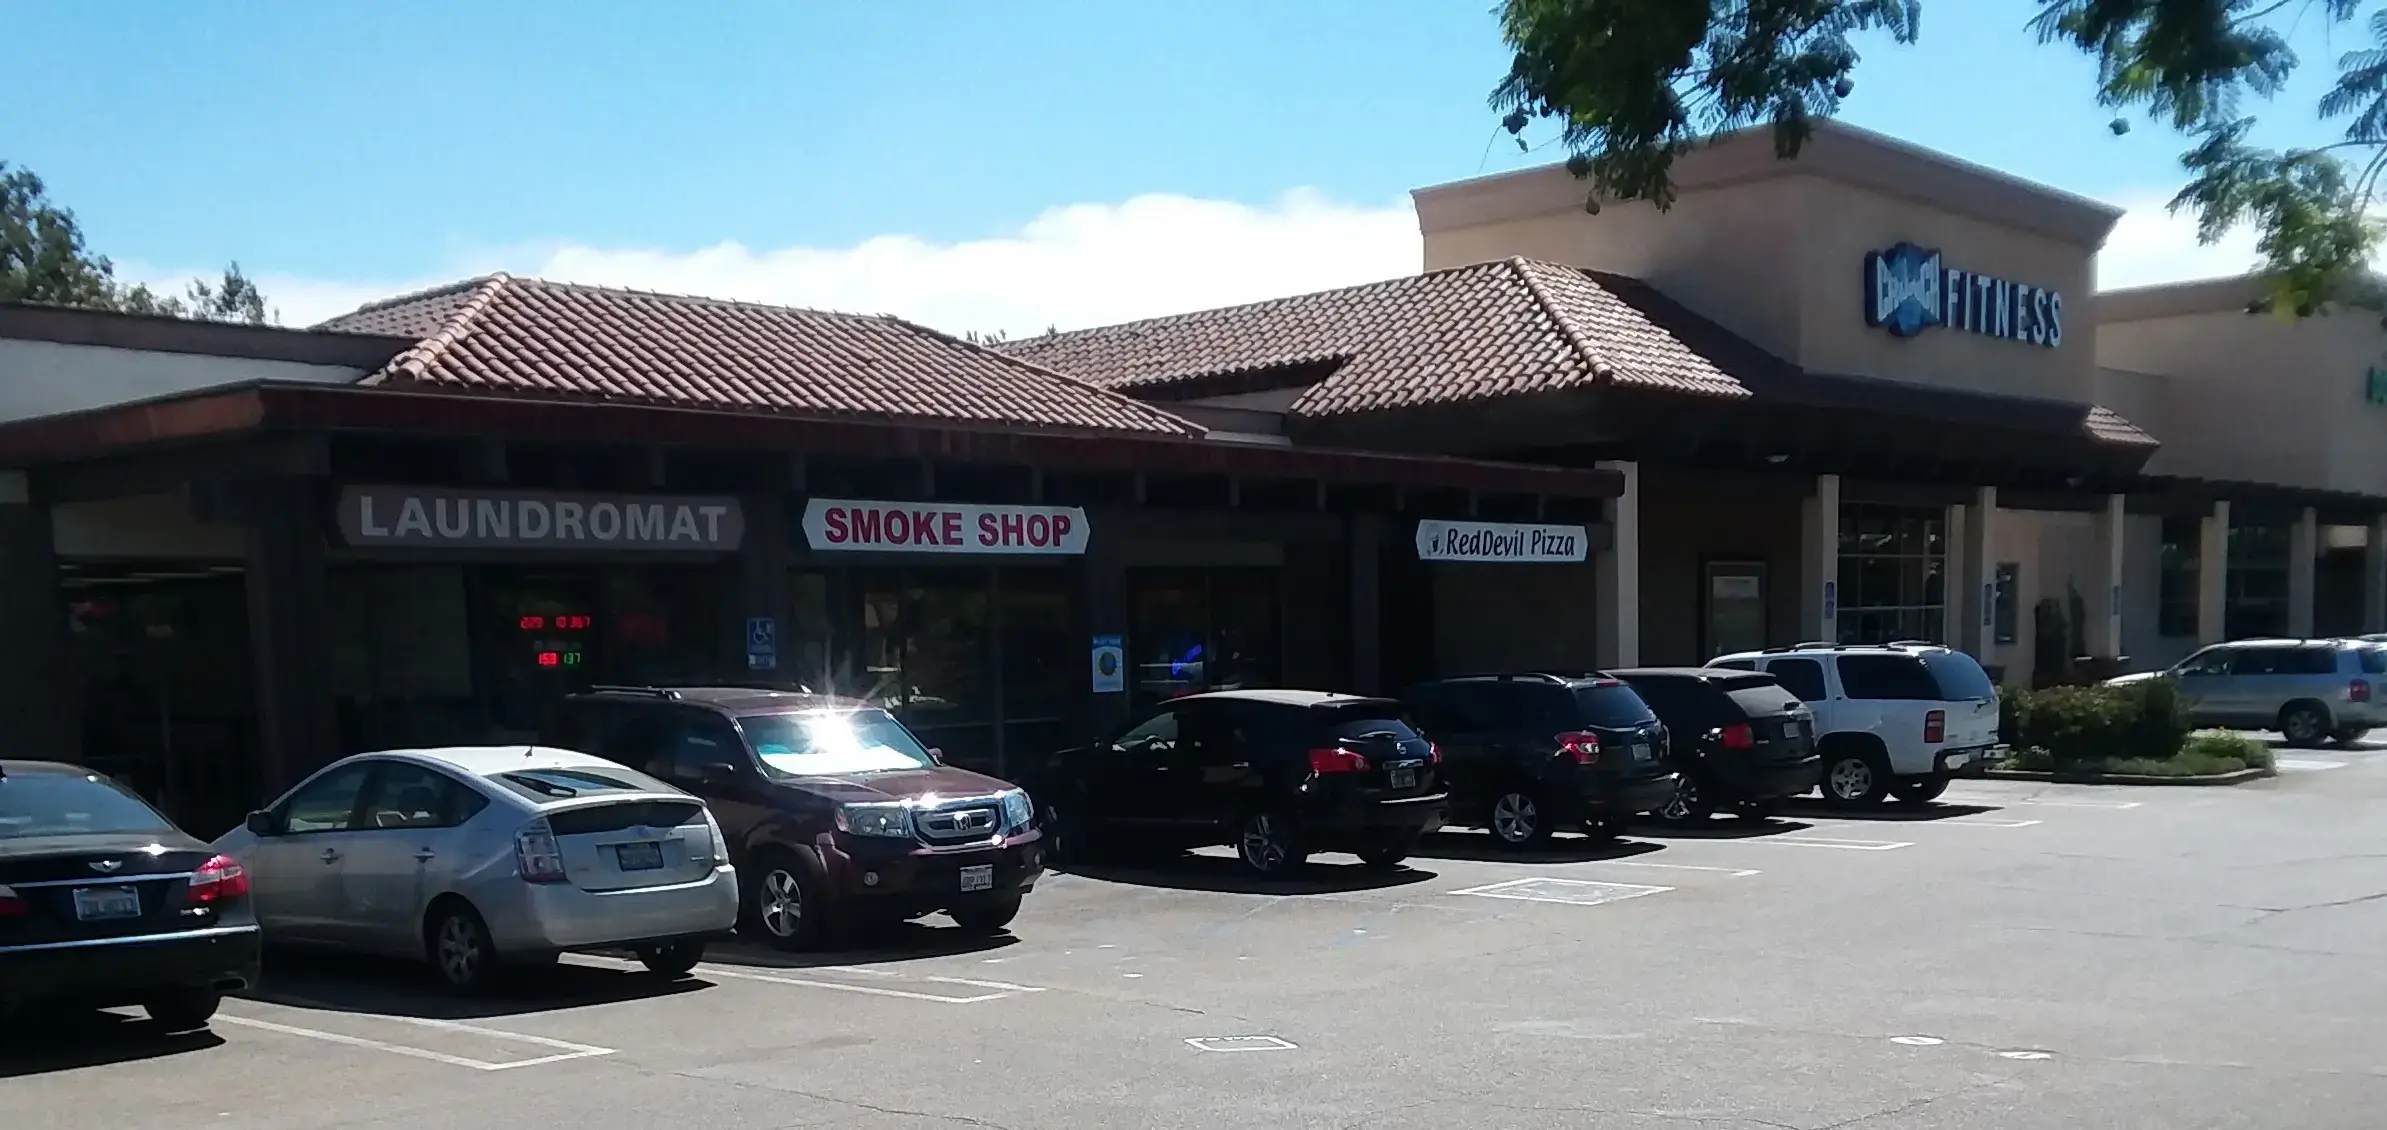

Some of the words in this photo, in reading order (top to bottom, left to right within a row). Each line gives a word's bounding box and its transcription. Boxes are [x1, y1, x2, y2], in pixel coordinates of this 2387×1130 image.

[1947, 269, 2063, 348] FITNESS
[359, 496, 728, 542] LAUNDROMAT
[824, 507, 964, 545] SMOKE
[978, 513, 1072, 547] SHOP
[1530, 529, 1575, 556] Pizza
